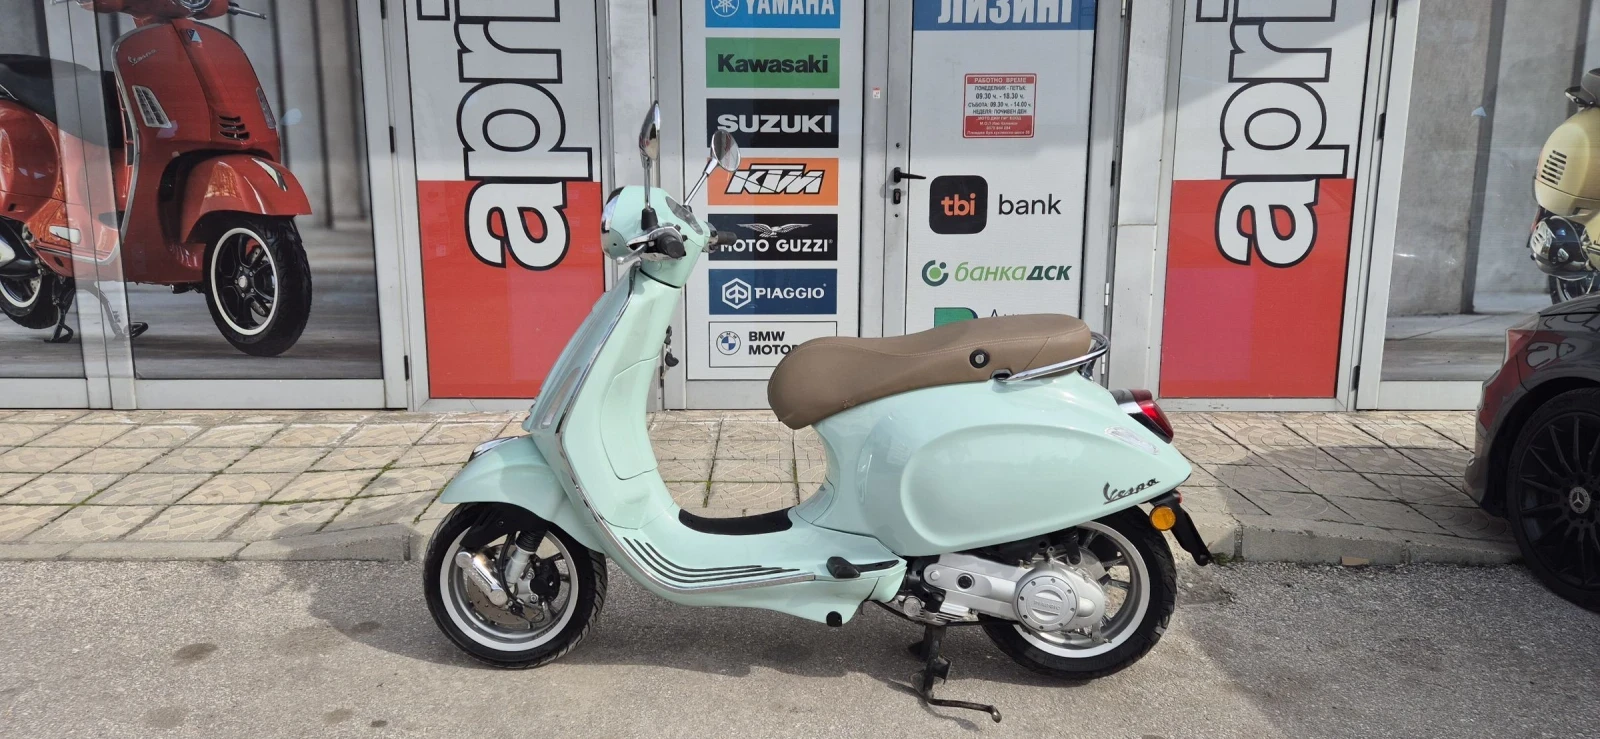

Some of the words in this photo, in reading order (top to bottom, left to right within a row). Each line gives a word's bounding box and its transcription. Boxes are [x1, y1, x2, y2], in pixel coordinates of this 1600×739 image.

[746, 0, 835, 15] YAMAHA
[717, 54, 828, 74] Kawasaki
[717, 114, 832, 133] SUZUKI
[725, 163, 825, 195] KTM
[940, 193, 976, 216] tbi
[998, 193, 1062, 215] bank
[748, 331, 785, 342] BMW
[1102, 478, 1160, 504] Vespa
